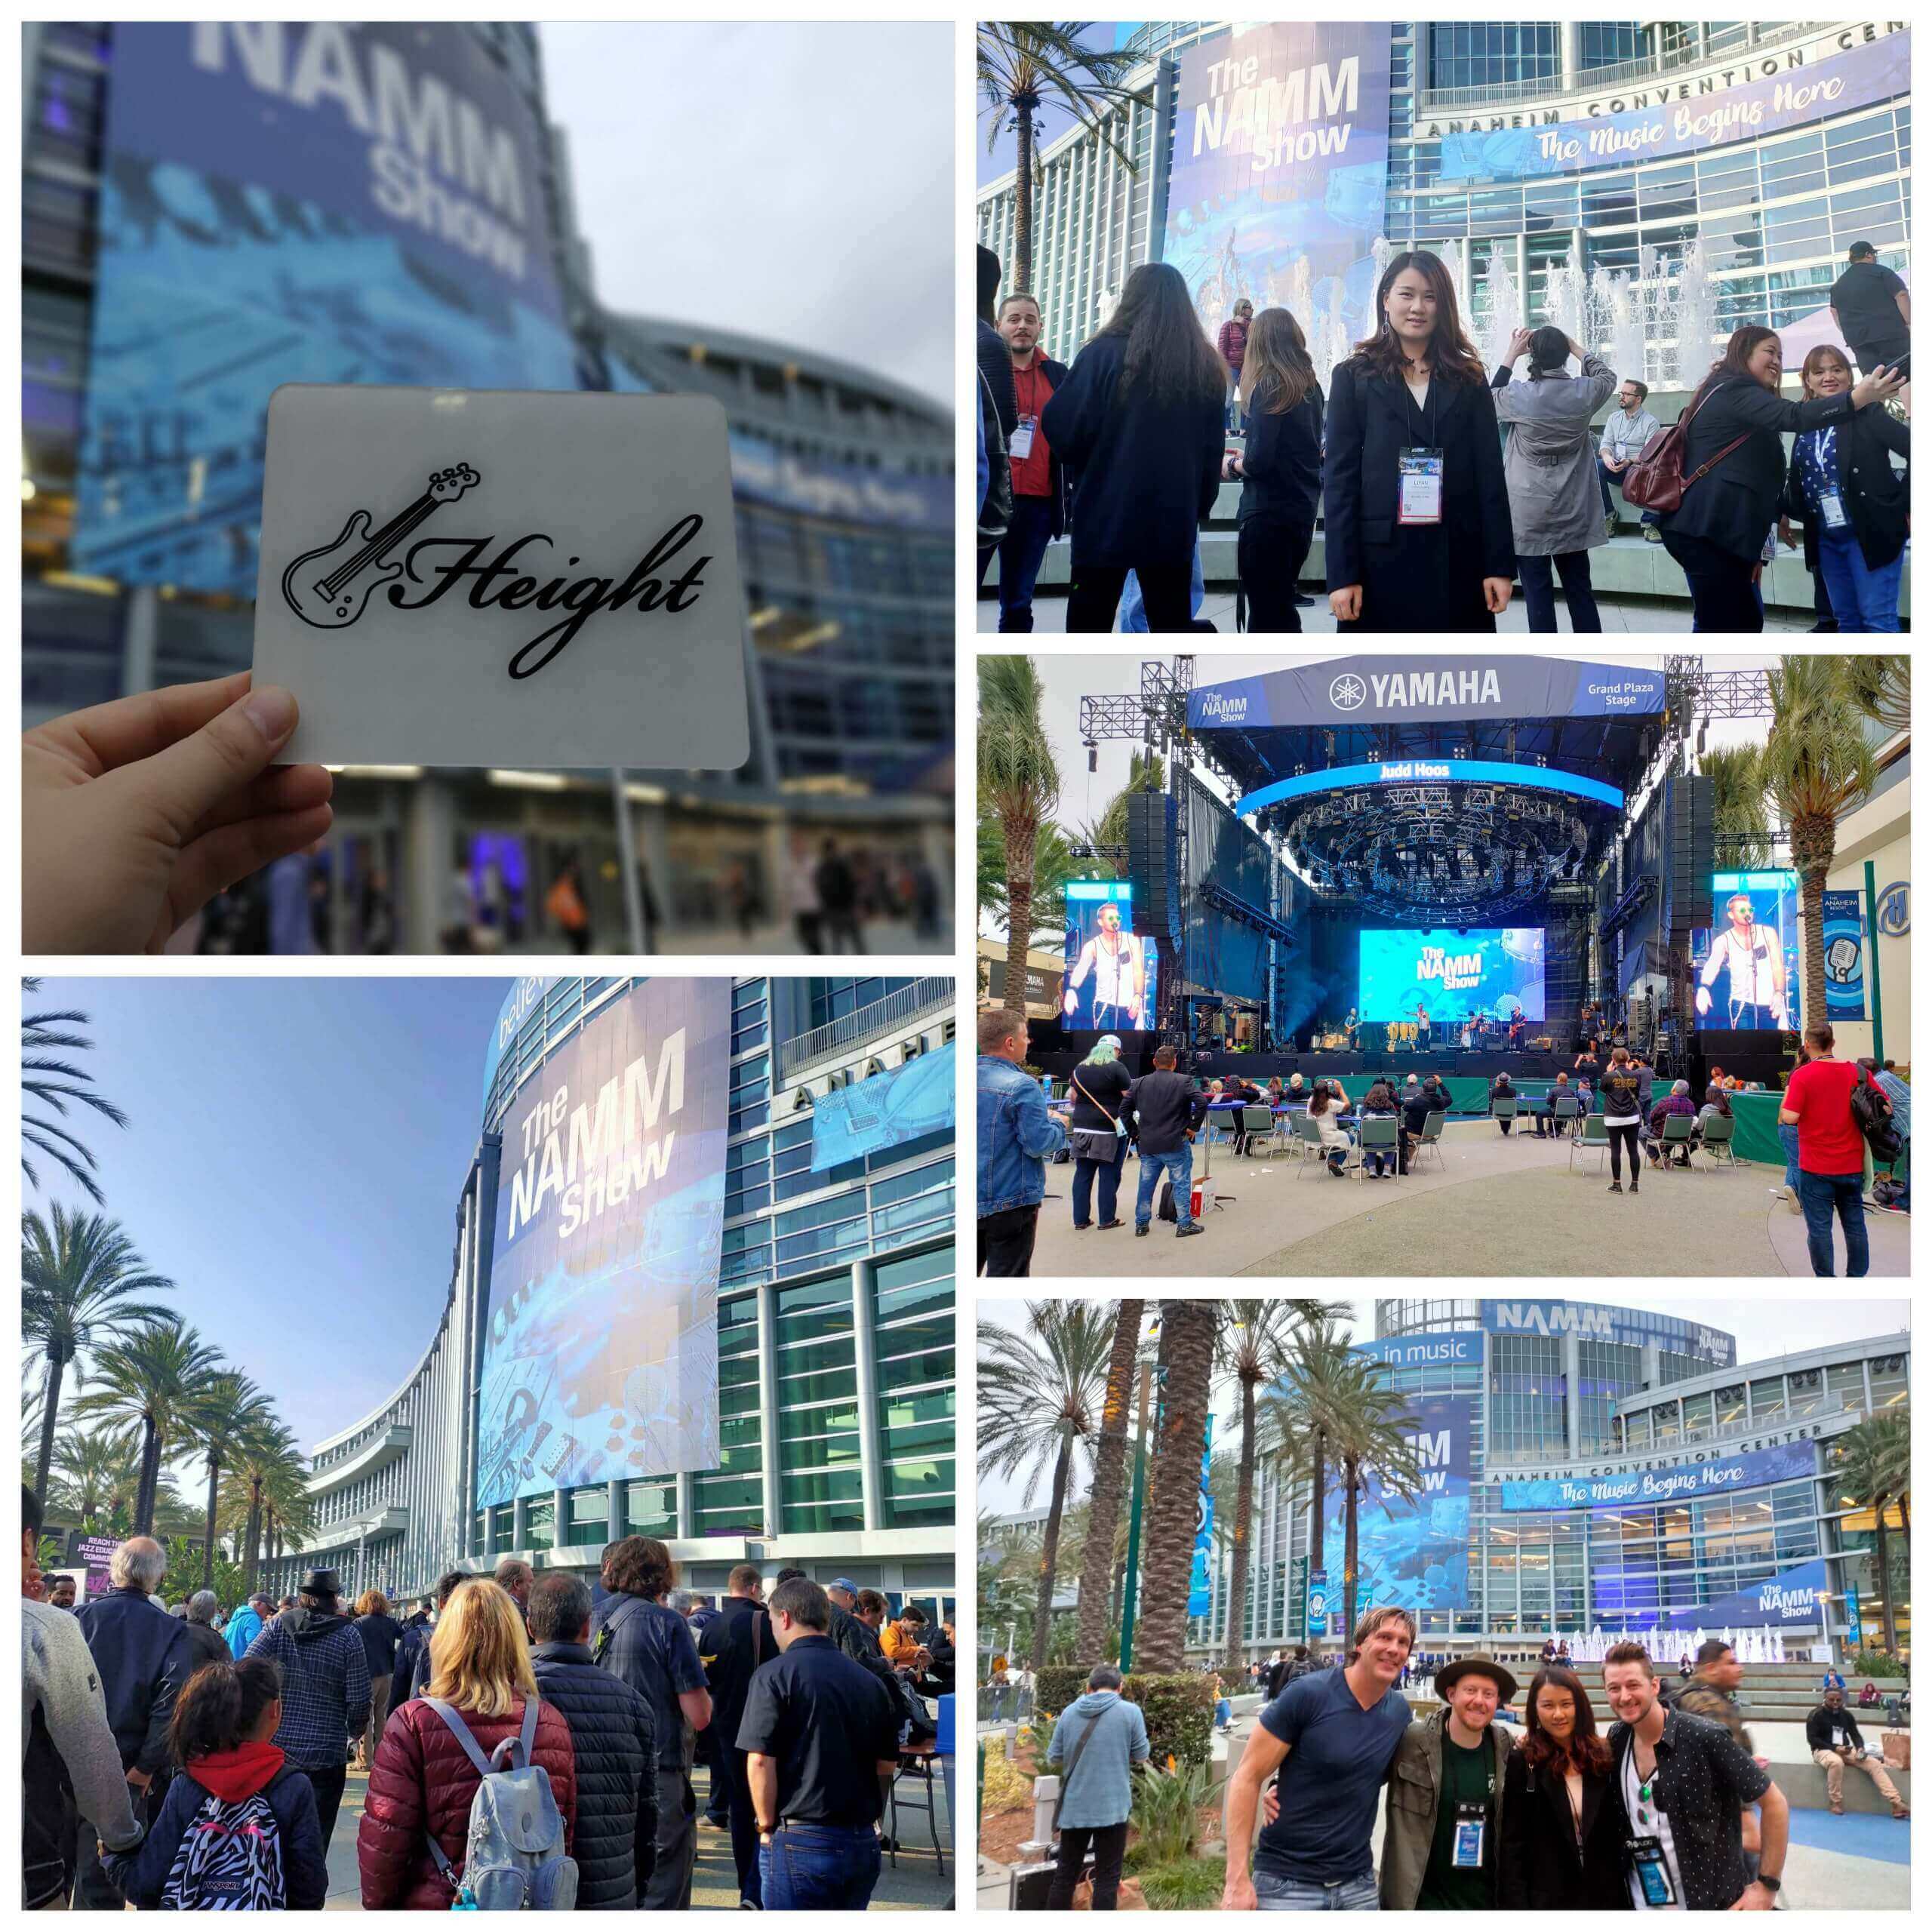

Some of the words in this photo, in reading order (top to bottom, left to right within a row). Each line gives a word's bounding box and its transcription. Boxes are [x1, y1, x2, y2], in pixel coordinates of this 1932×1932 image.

[1208, 55, 1259, 98] The
[1429, 109, 1560, 137] ANAHEIM
[1588, 49, 1803, 116] CONVENTION
[1192, 56, 1359, 157] NAMM
[1537, 131, 1583, 162] The
[1589, 120, 1665, 155] Music
[1673, 101, 1766, 143] Begins
[1774, 76, 1846, 112] Here
[1251, 123, 1352, 171] Show
[370, 142, 526, 281] Show
[387, 514, 714, 679] Height
[1205, 693, 1222, 702] The
[1371, 669, 1502, 708] YAMAHA
[1588, 683, 1620, 694] Grand
[1624, 682, 1654, 693] Plaza
[1605, 695, 1636, 706] Stage
[1202, 697, 1247, 716] NAMM
[1220, 712, 1245, 723] Show
[1380, 764, 1411, 779] Judd
[1415, 762, 1449, 777] Hoos
[1417, 952, 1482, 980] NAMM
[1420, 946, 1445, 960] The
[1443, 974, 1479, 990] Show
[508, 1026, 686, 1241] NAMM
[522, 1084, 568, 1160] The
[558, 1130, 676, 1238] Show
[1497, 1303, 1612, 1335] NAMM
[1385, 1346, 1401, 1364] in
[1407, 1339, 1467, 1362] music
[1699, 1335, 1728, 1352] NAMM
[1493, 1471, 1574, 1482] ANAHEIM
[1591, 1449, 1721, 1477] CONVENTION
[1740, 1425, 1821, 1454] CENTER
[1560, 1482, 1588, 1502] The
[1592, 1482, 1639, 1500] Music
[1643, 1472, 1698, 1498] Begins
[1702, 1466, 1745, 1484] Here
[78, 1544, 95, 1552] JAZZ
[88, 1537, 110, 1547] REACH
[1759, 1587, 1814, 1612] NAMM
[1762, 1585, 1782, 1595] The
[1781, 1605, 1813, 1618] Show
